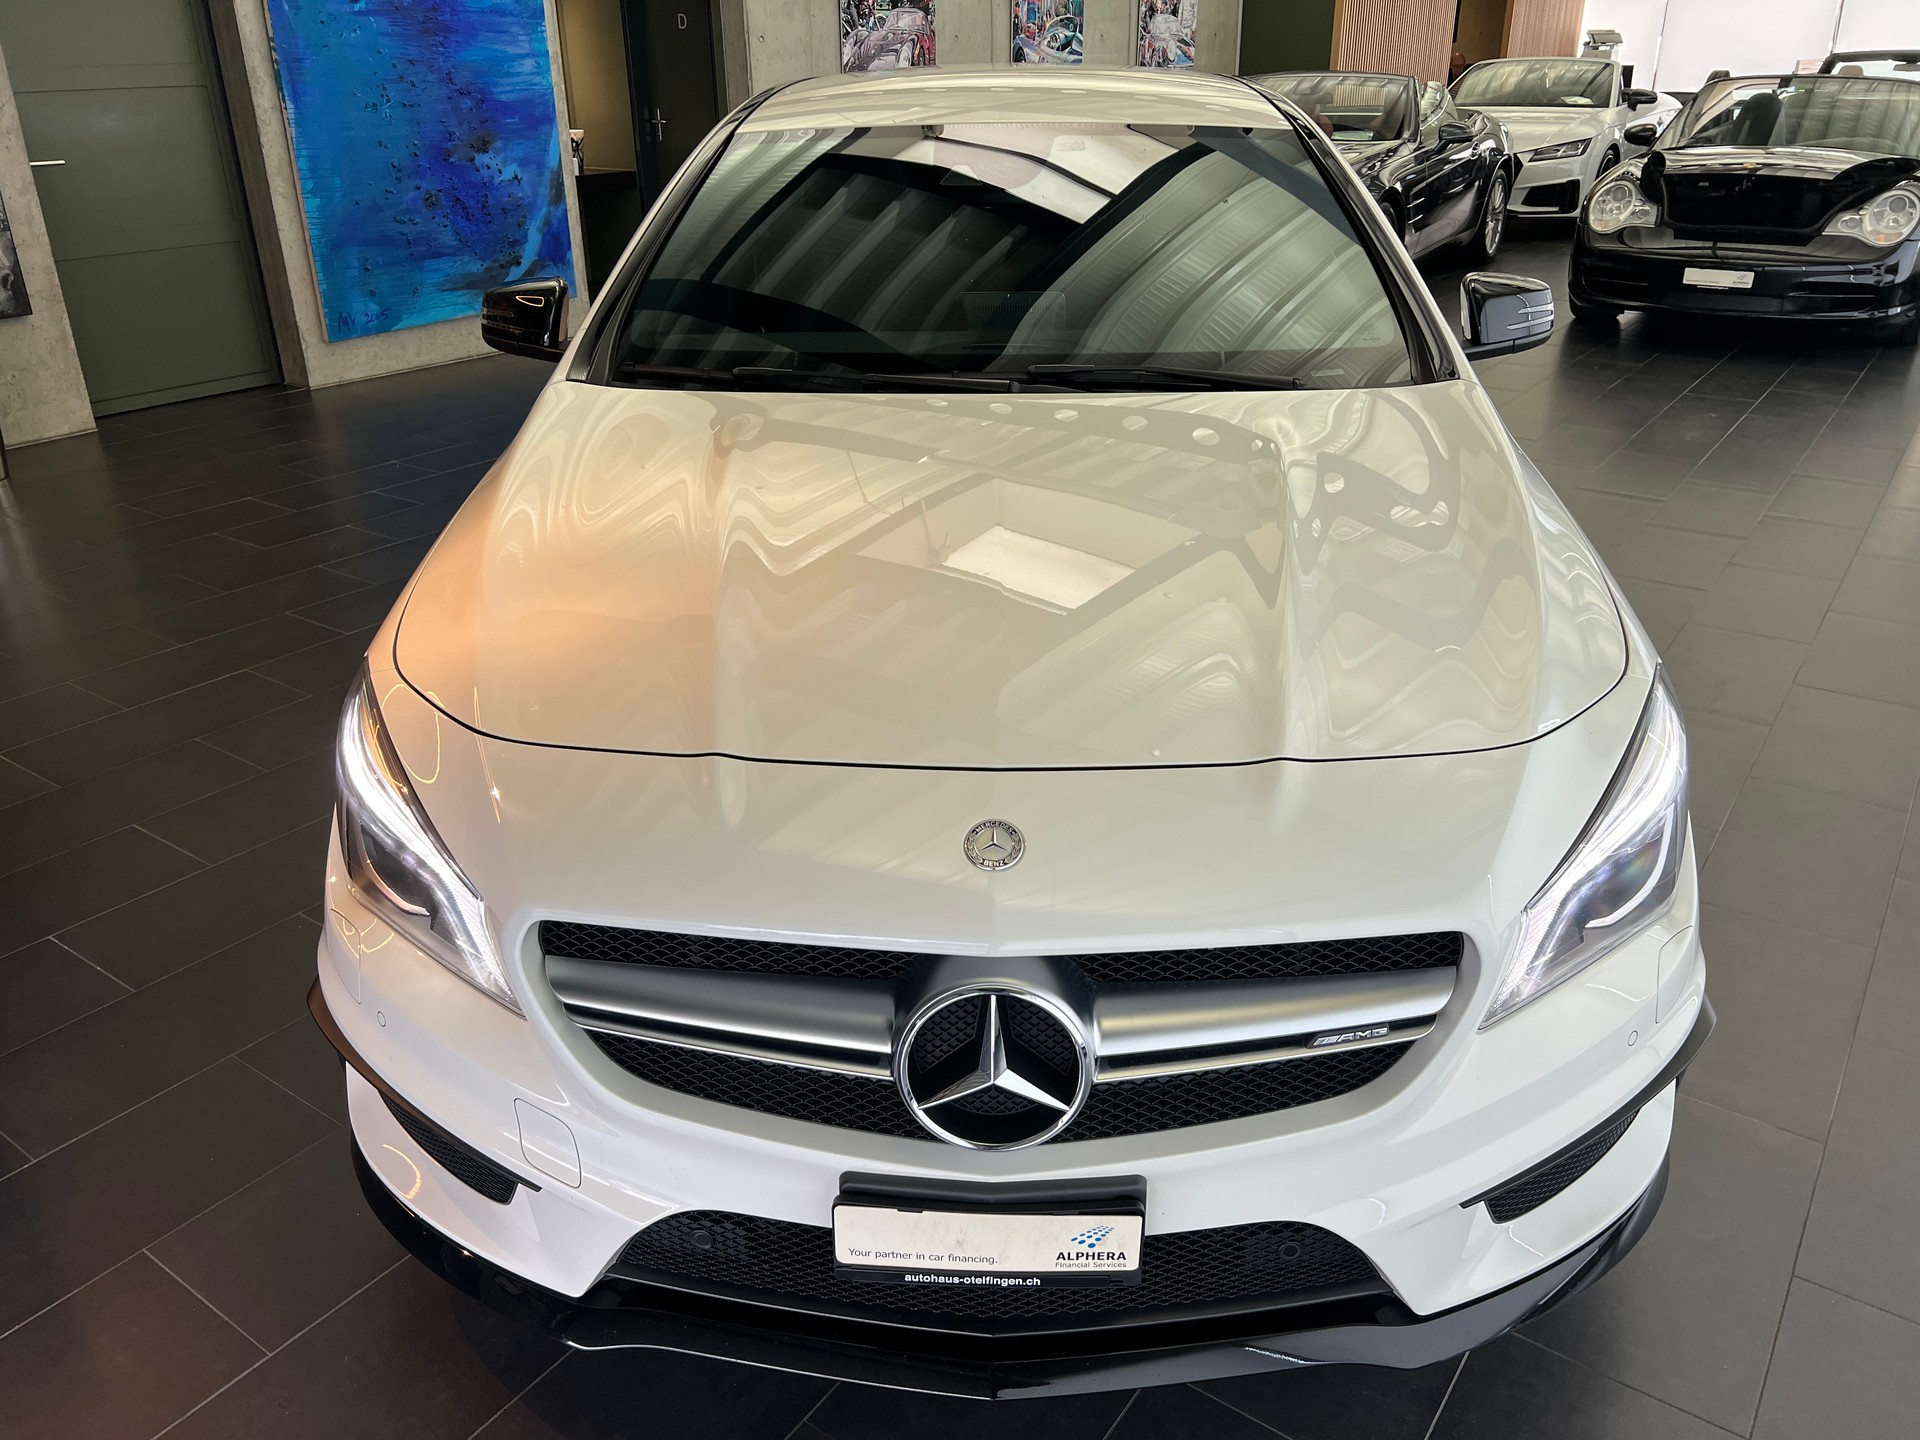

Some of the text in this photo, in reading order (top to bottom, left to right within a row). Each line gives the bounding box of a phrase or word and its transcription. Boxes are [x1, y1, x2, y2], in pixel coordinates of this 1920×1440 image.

[677, 13, 688, 30] D
[975, 821, 1014, 833] MERCEDES
[983, 859, 1006, 868] BENZ
[848, 1248, 871, 1257] Your
[875, 1250, 913, 1259] partner
[916, 1252, 925, 1260] in
[948, 1254, 998, 1265] financing.
[1056, 1251, 1127, 1261] ALPHERA
[904, 1273, 1041, 1286] autohaus-otelfingen.ch
